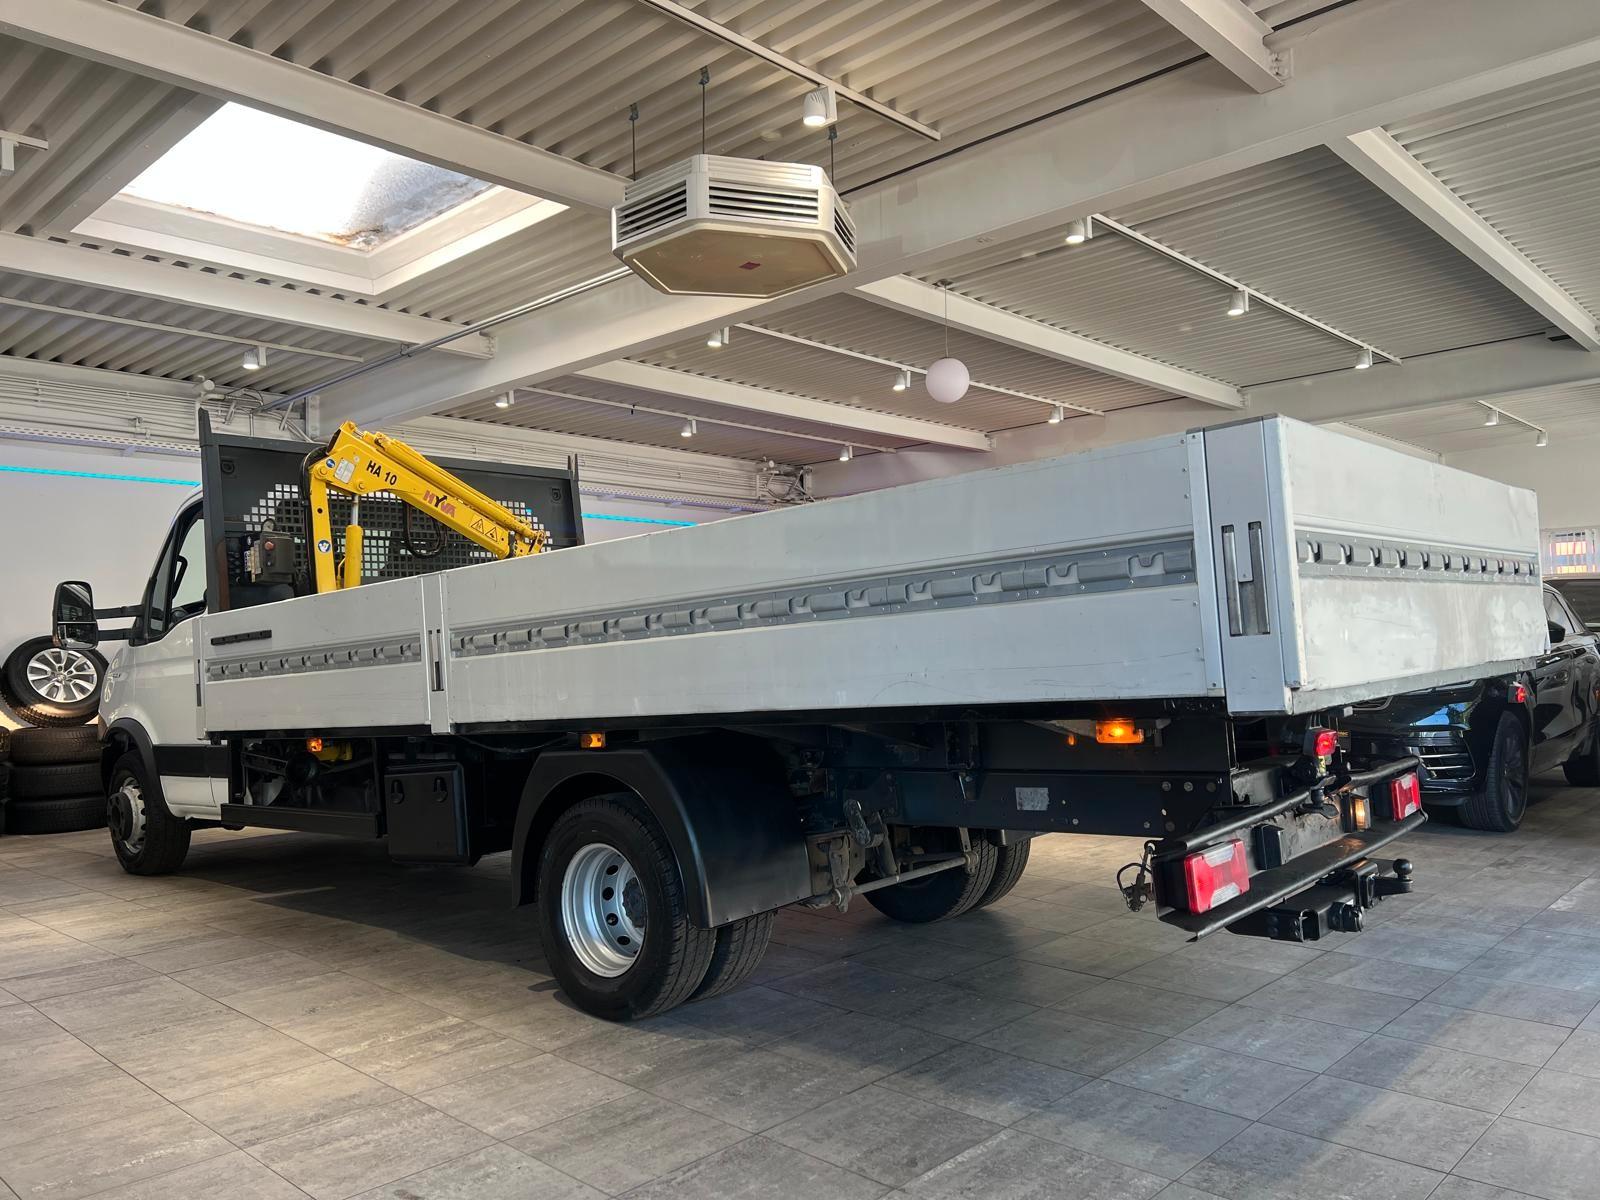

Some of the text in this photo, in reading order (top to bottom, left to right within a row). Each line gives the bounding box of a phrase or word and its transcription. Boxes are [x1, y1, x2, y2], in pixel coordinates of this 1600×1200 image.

[366, 460, 382, 477] HA
[384, 471, 397, 485] 10
[423, 490, 456, 518] HYVA
